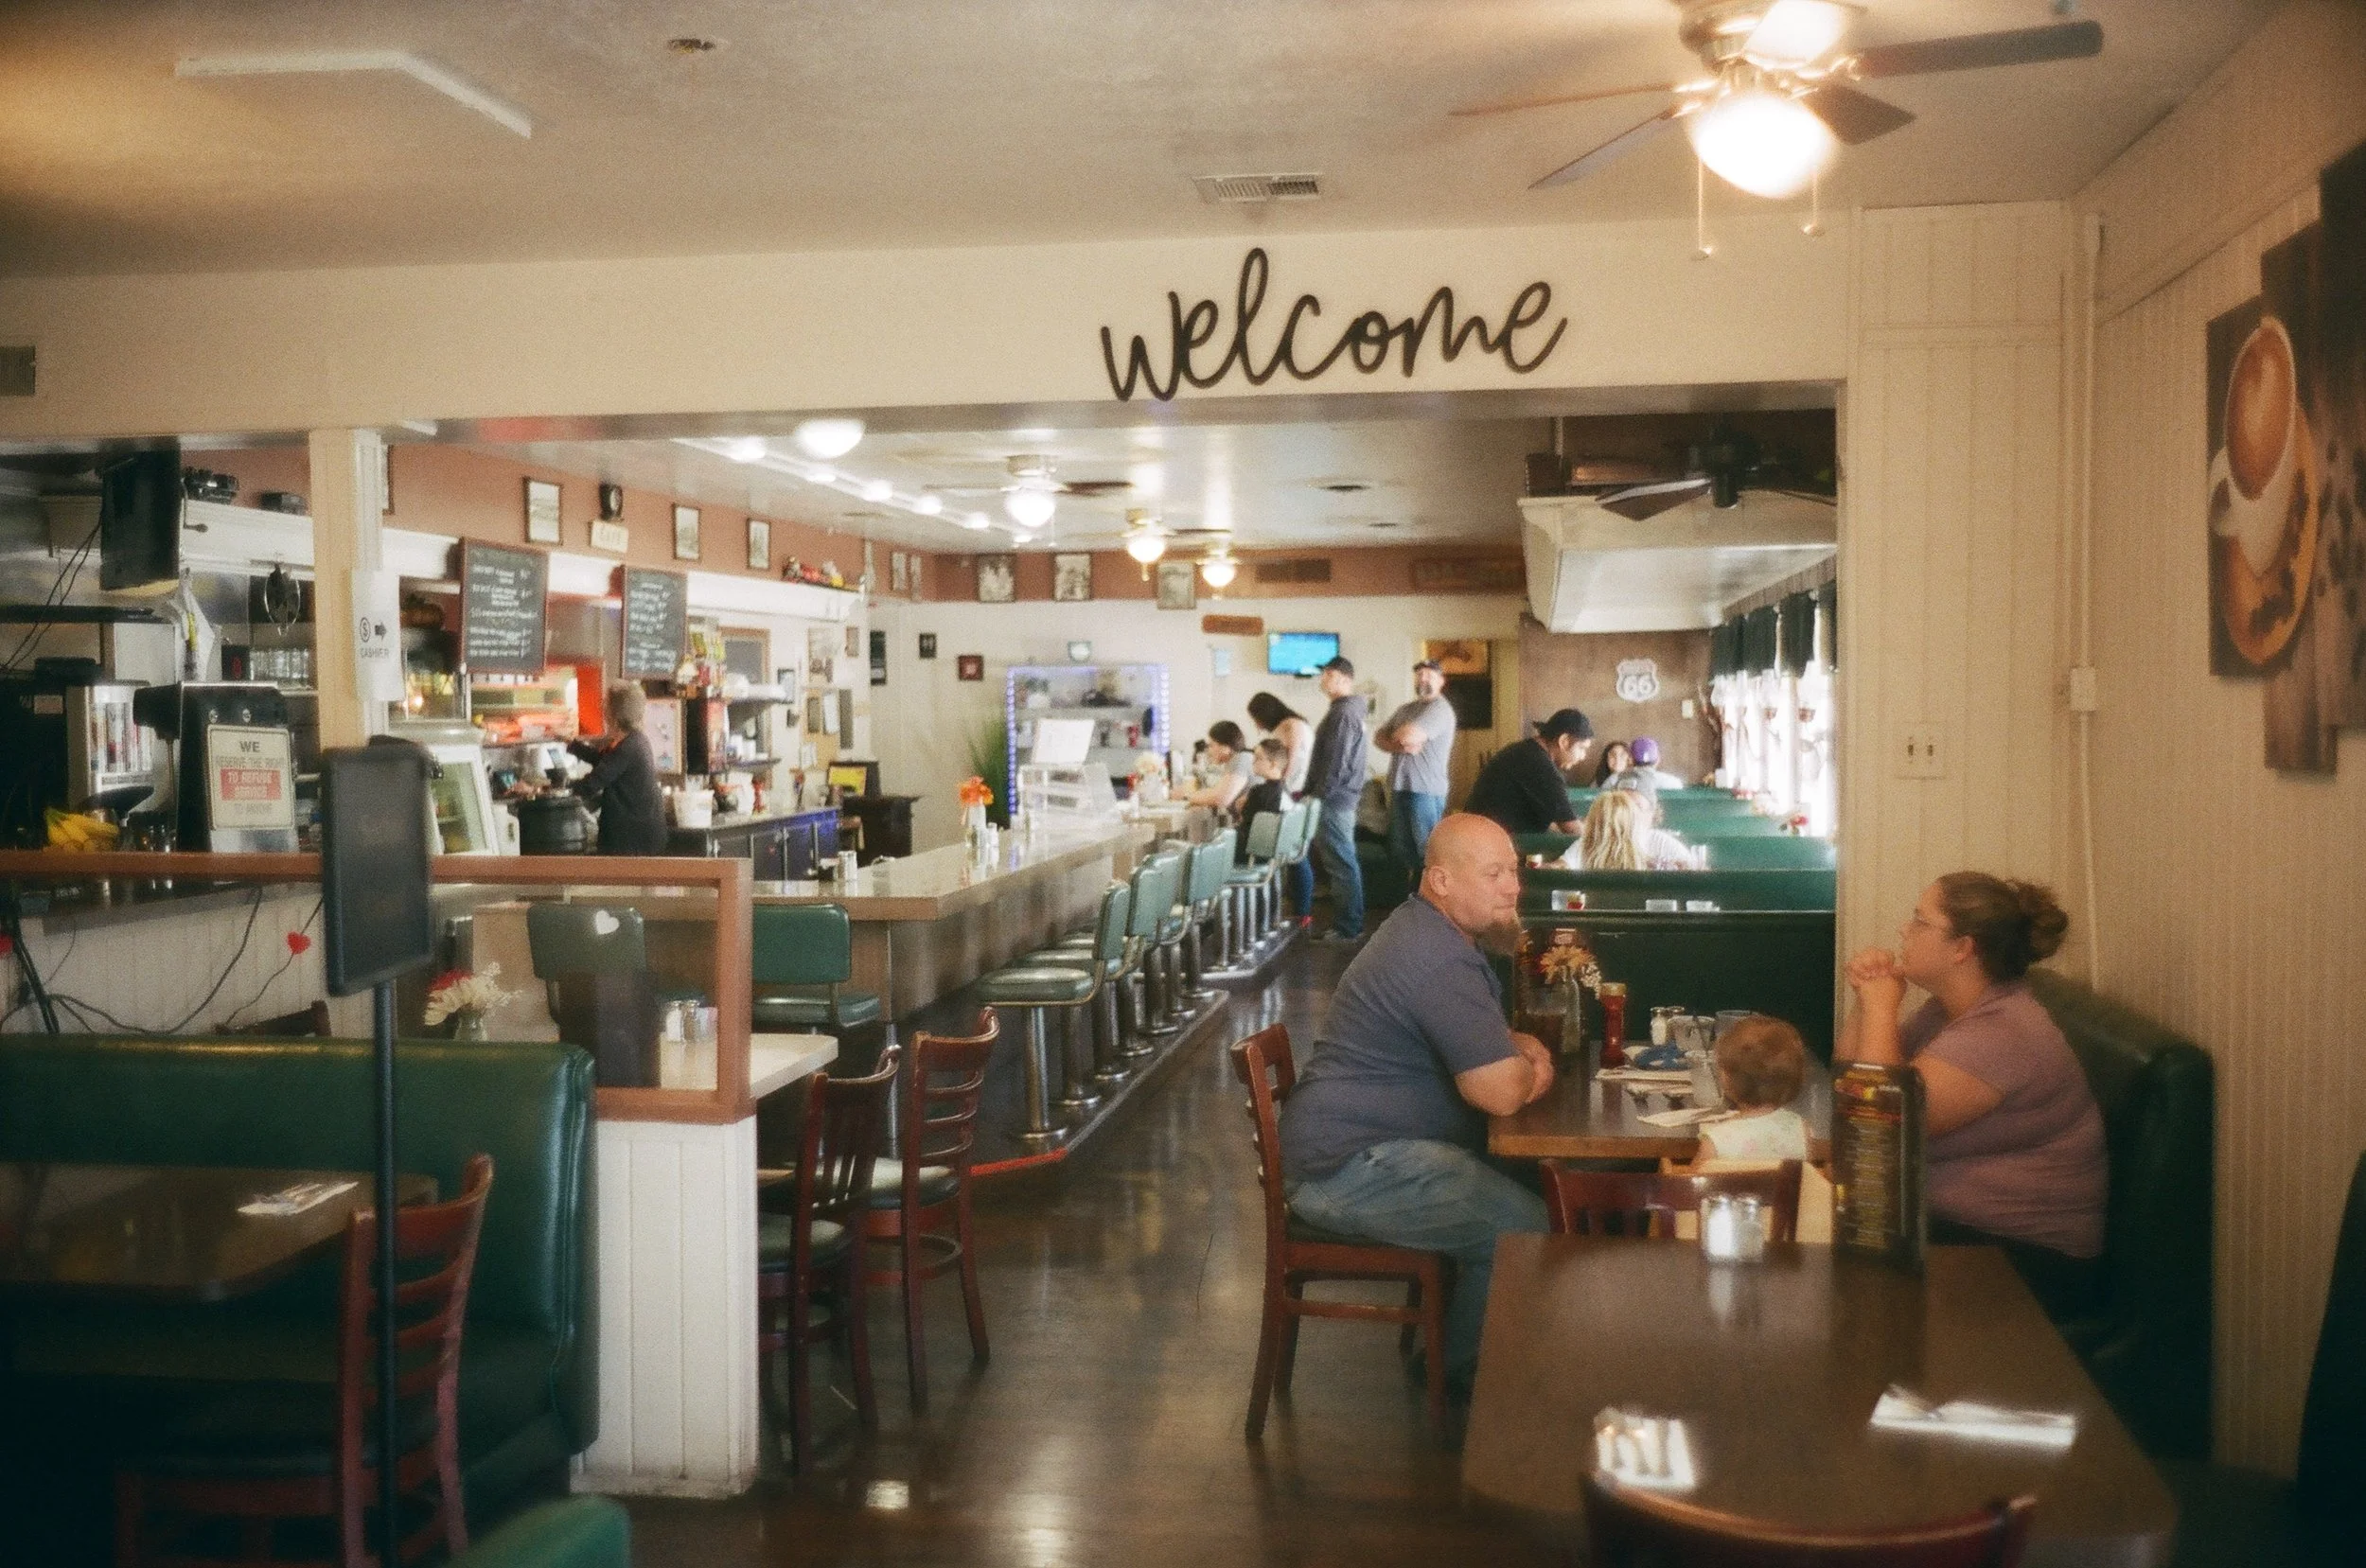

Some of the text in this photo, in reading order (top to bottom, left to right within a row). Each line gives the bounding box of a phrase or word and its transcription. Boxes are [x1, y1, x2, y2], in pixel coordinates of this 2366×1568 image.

[1101, 246, 1568, 402] welcome
[1621, 675, 1654, 696] 66
[239, 741, 260, 752] WE
